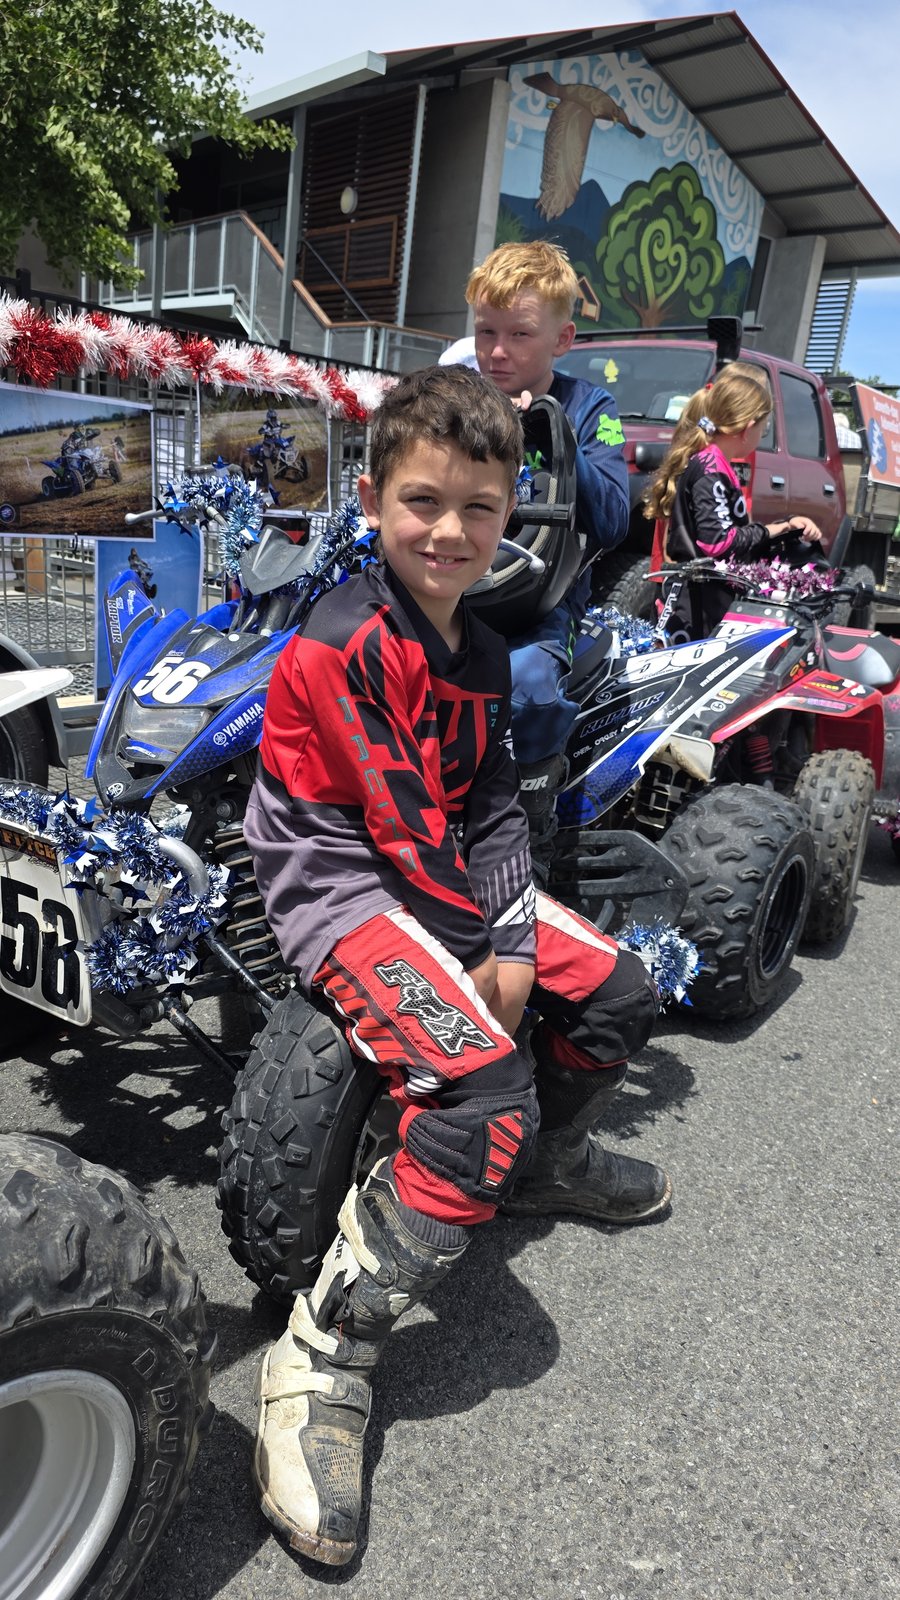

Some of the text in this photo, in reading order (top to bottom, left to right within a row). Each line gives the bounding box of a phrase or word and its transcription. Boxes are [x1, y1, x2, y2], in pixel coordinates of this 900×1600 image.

[106, 599, 123, 644] RAPTOR
[132, 656, 212, 704] 56
[222, 702, 265, 738] YAMAHA
[579, 691, 665, 739] RAPTOR
[336, 696, 418, 872] RACING
